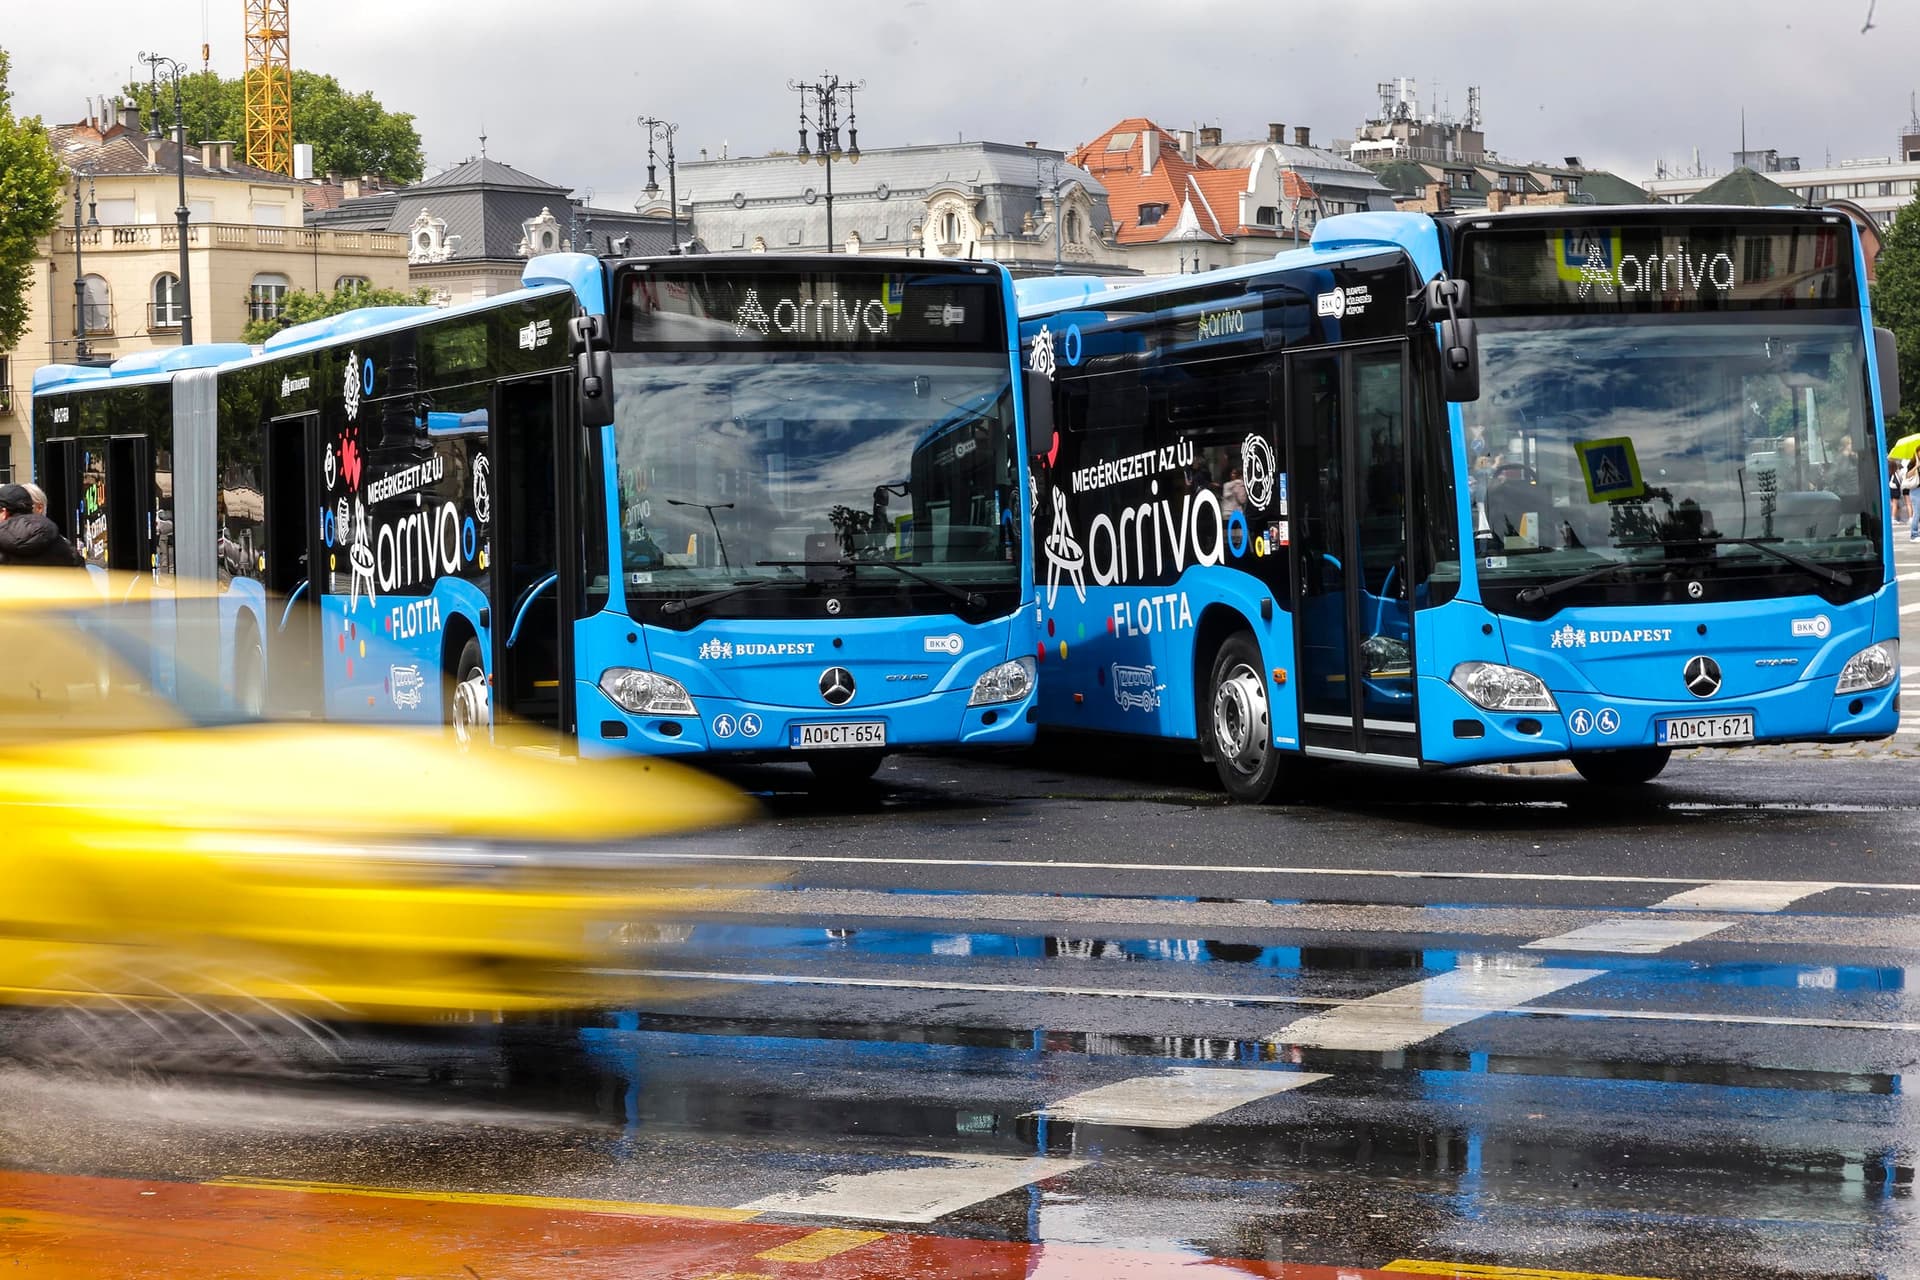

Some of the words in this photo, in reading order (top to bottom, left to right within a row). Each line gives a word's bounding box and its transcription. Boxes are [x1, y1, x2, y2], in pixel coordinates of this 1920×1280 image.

[1617, 245, 1735, 292] arriva
[773, 291, 888, 334] arriva
[367, 467, 421, 506] MEGÉRKEZETT
[421, 462, 433, 486] AZ
[432, 452, 443, 481] ÚJ
[1072, 450, 1157, 494] MEGÉRKEZETT
[1159, 446, 1175, 472] AZ
[1177, 436, 1194, 467] ÚJ
[377, 492, 461, 593] arriva
[1088, 479, 1225, 587] arriva
[391, 597, 441, 640] FLOTTA
[1113, 591, 1193, 638] FLOTTA
[1589, 629, 1672, 644] BUDAPEST
[1796, 623, 1814, 632] BKK
[735, 643, 815, 656] BUDAPEST
